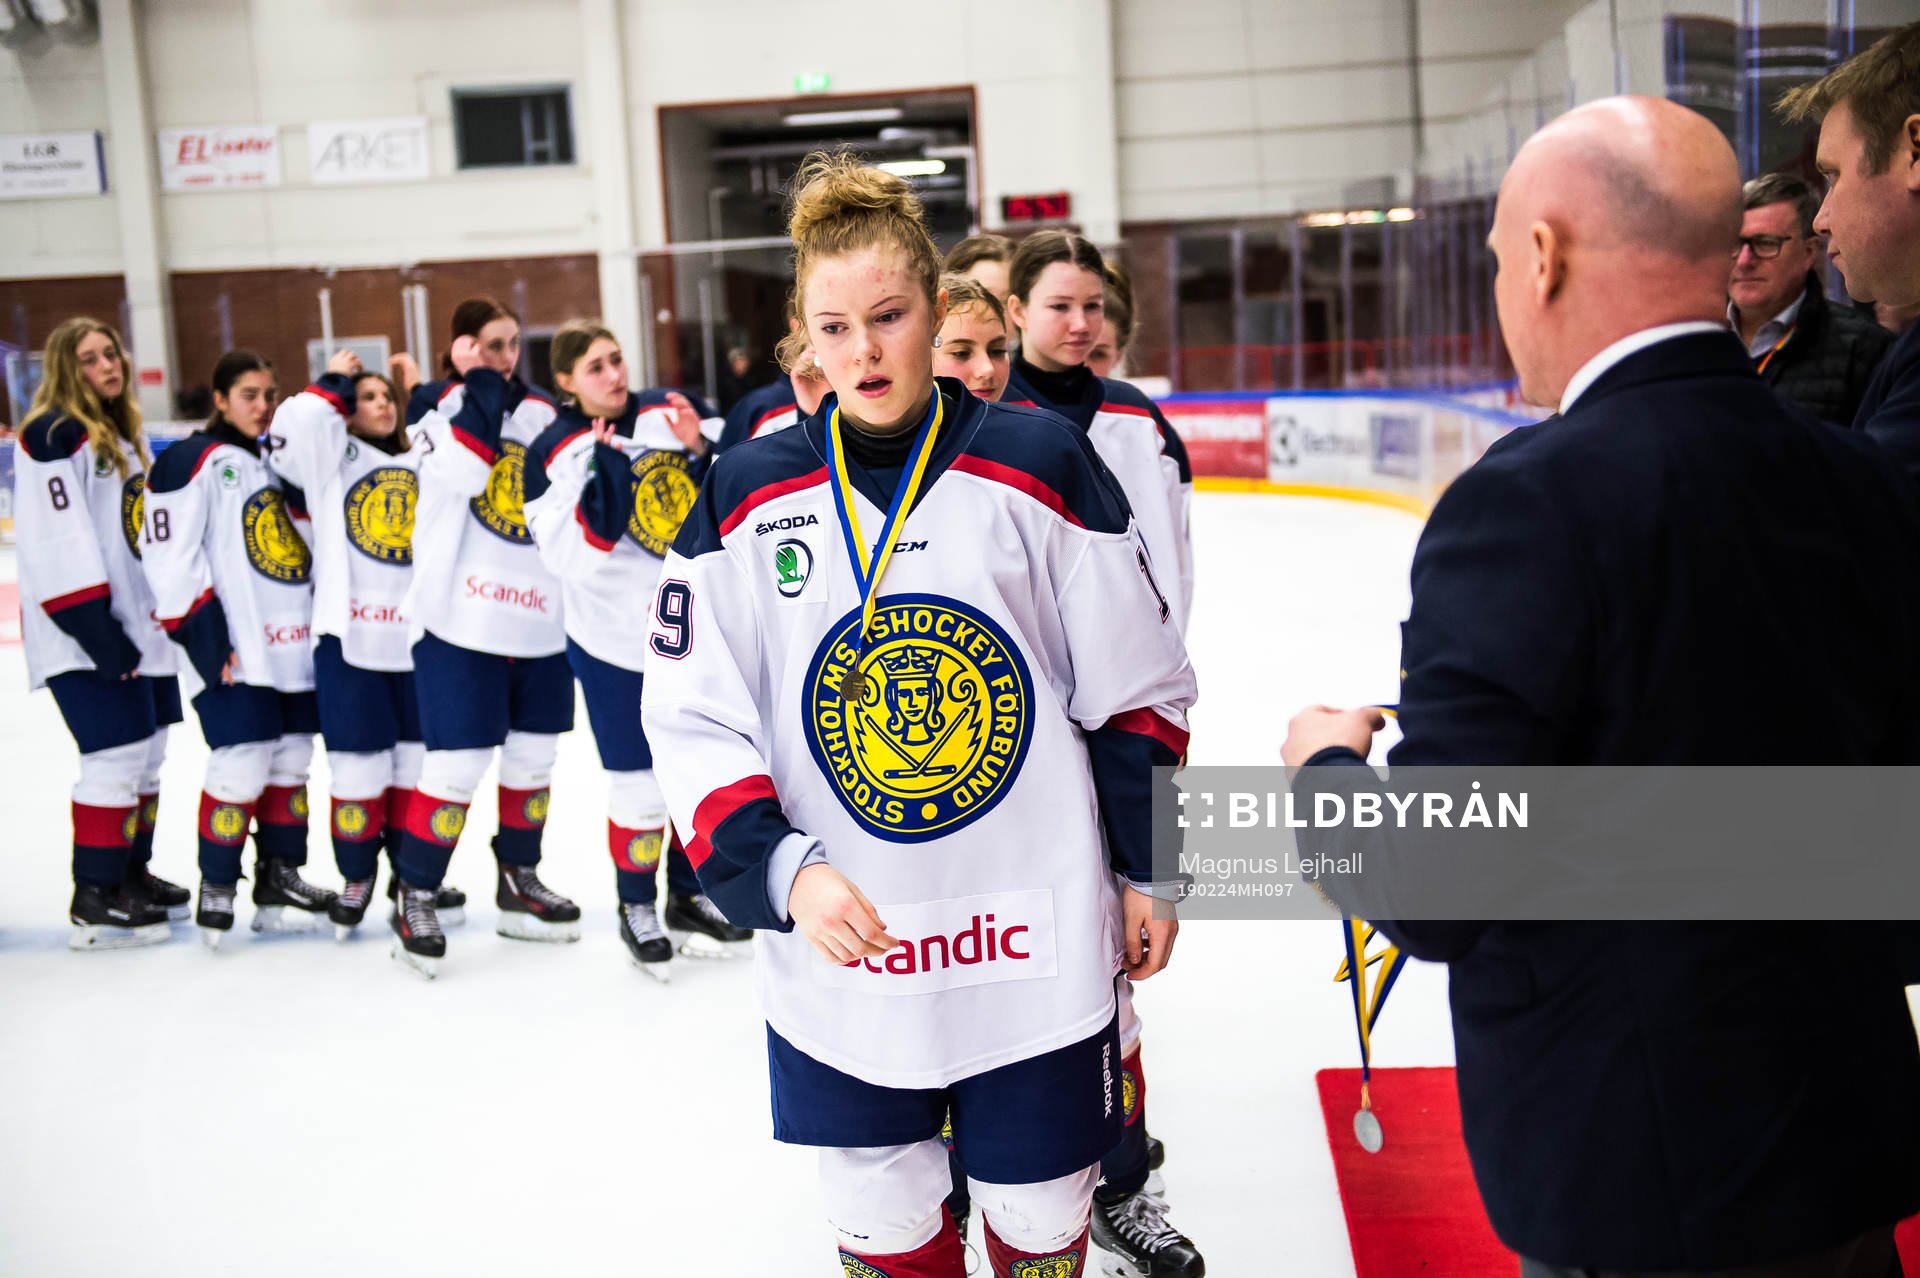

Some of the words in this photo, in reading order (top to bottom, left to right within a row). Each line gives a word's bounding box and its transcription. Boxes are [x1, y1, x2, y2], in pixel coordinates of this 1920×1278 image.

[48, 476, 70, 511] 8
[145, 508, 170, 544] 18
[755, 514, 819, 537] ŠKODA
[872, 540, 928, 554] CM
[466, 574, 549, 613] Scandic
[650, 578, 694, 660] 9
[820, 642, 904, 823] STOCKHOLMS
[953, 674, 1019, 808] FÖRBUND
[844, 913, 1030, 975] andic
[1102, 1042, 1113, 1119] Reebok
